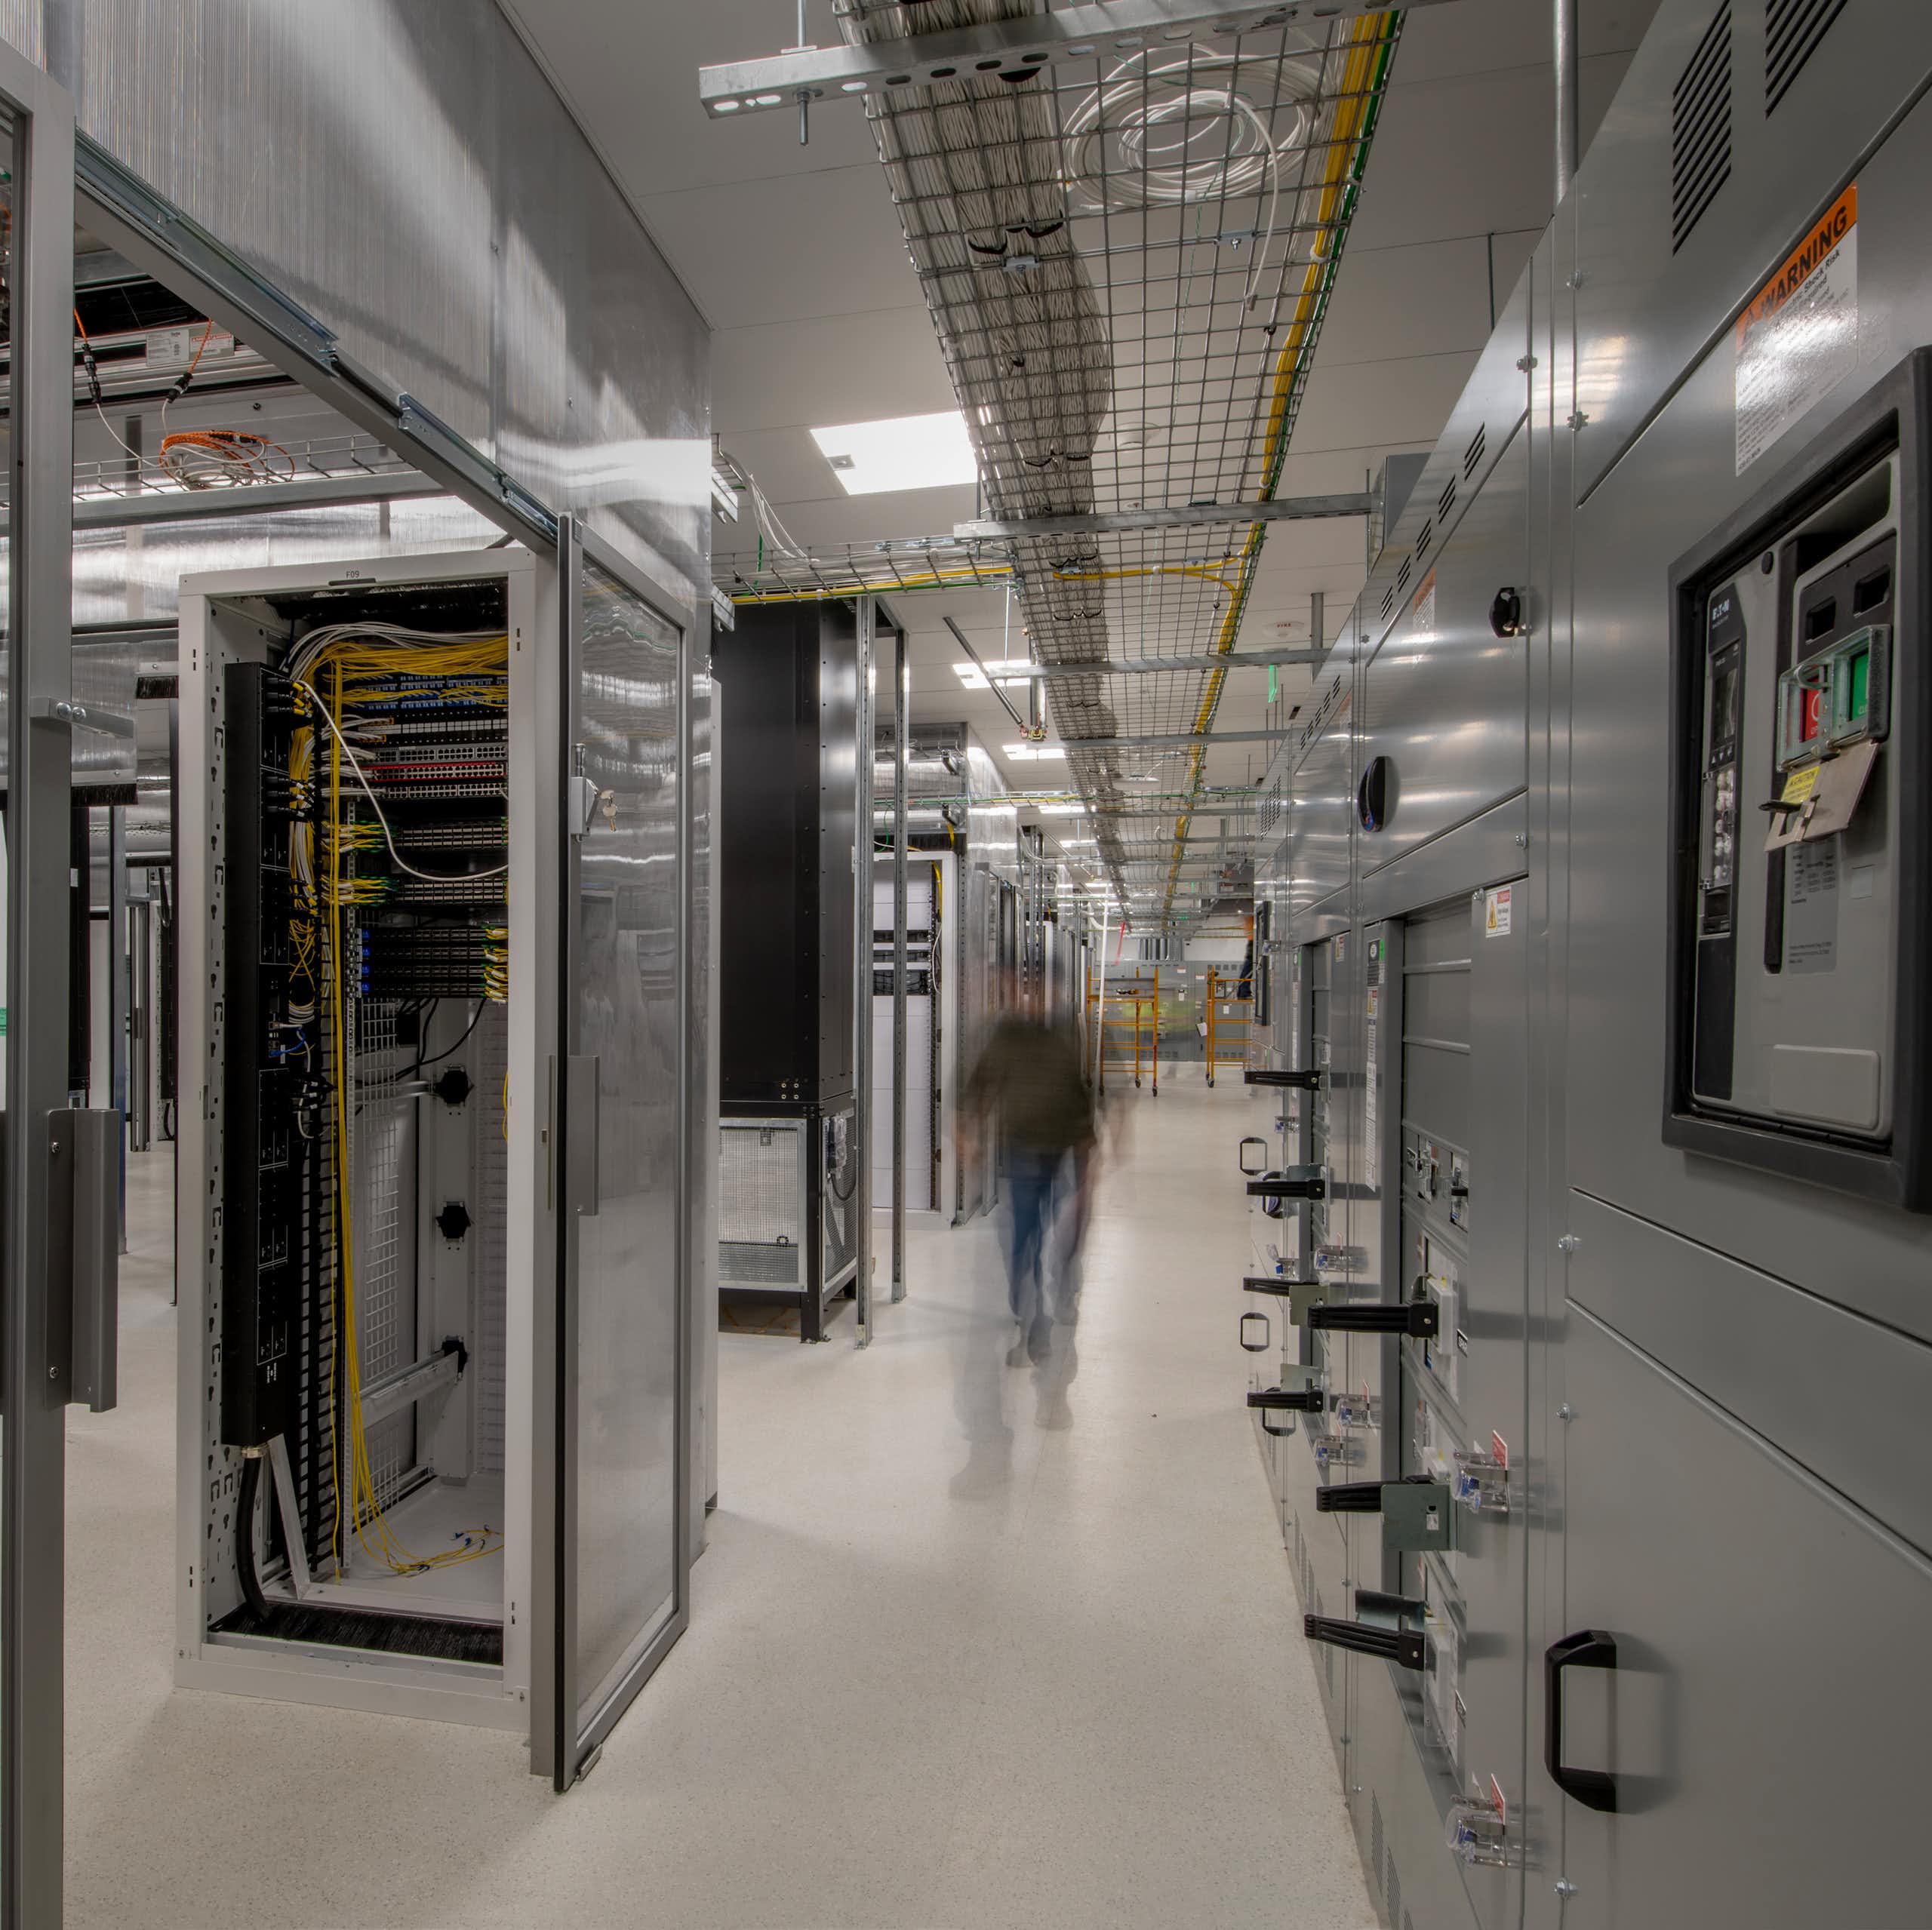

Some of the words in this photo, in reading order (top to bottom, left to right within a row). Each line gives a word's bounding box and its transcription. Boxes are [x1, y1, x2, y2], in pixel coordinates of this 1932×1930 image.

[1761, 204, 1847, 318] WARNING
[1825, 248, 1840, 271] Risk
[346, 570, 360, 579] F09
